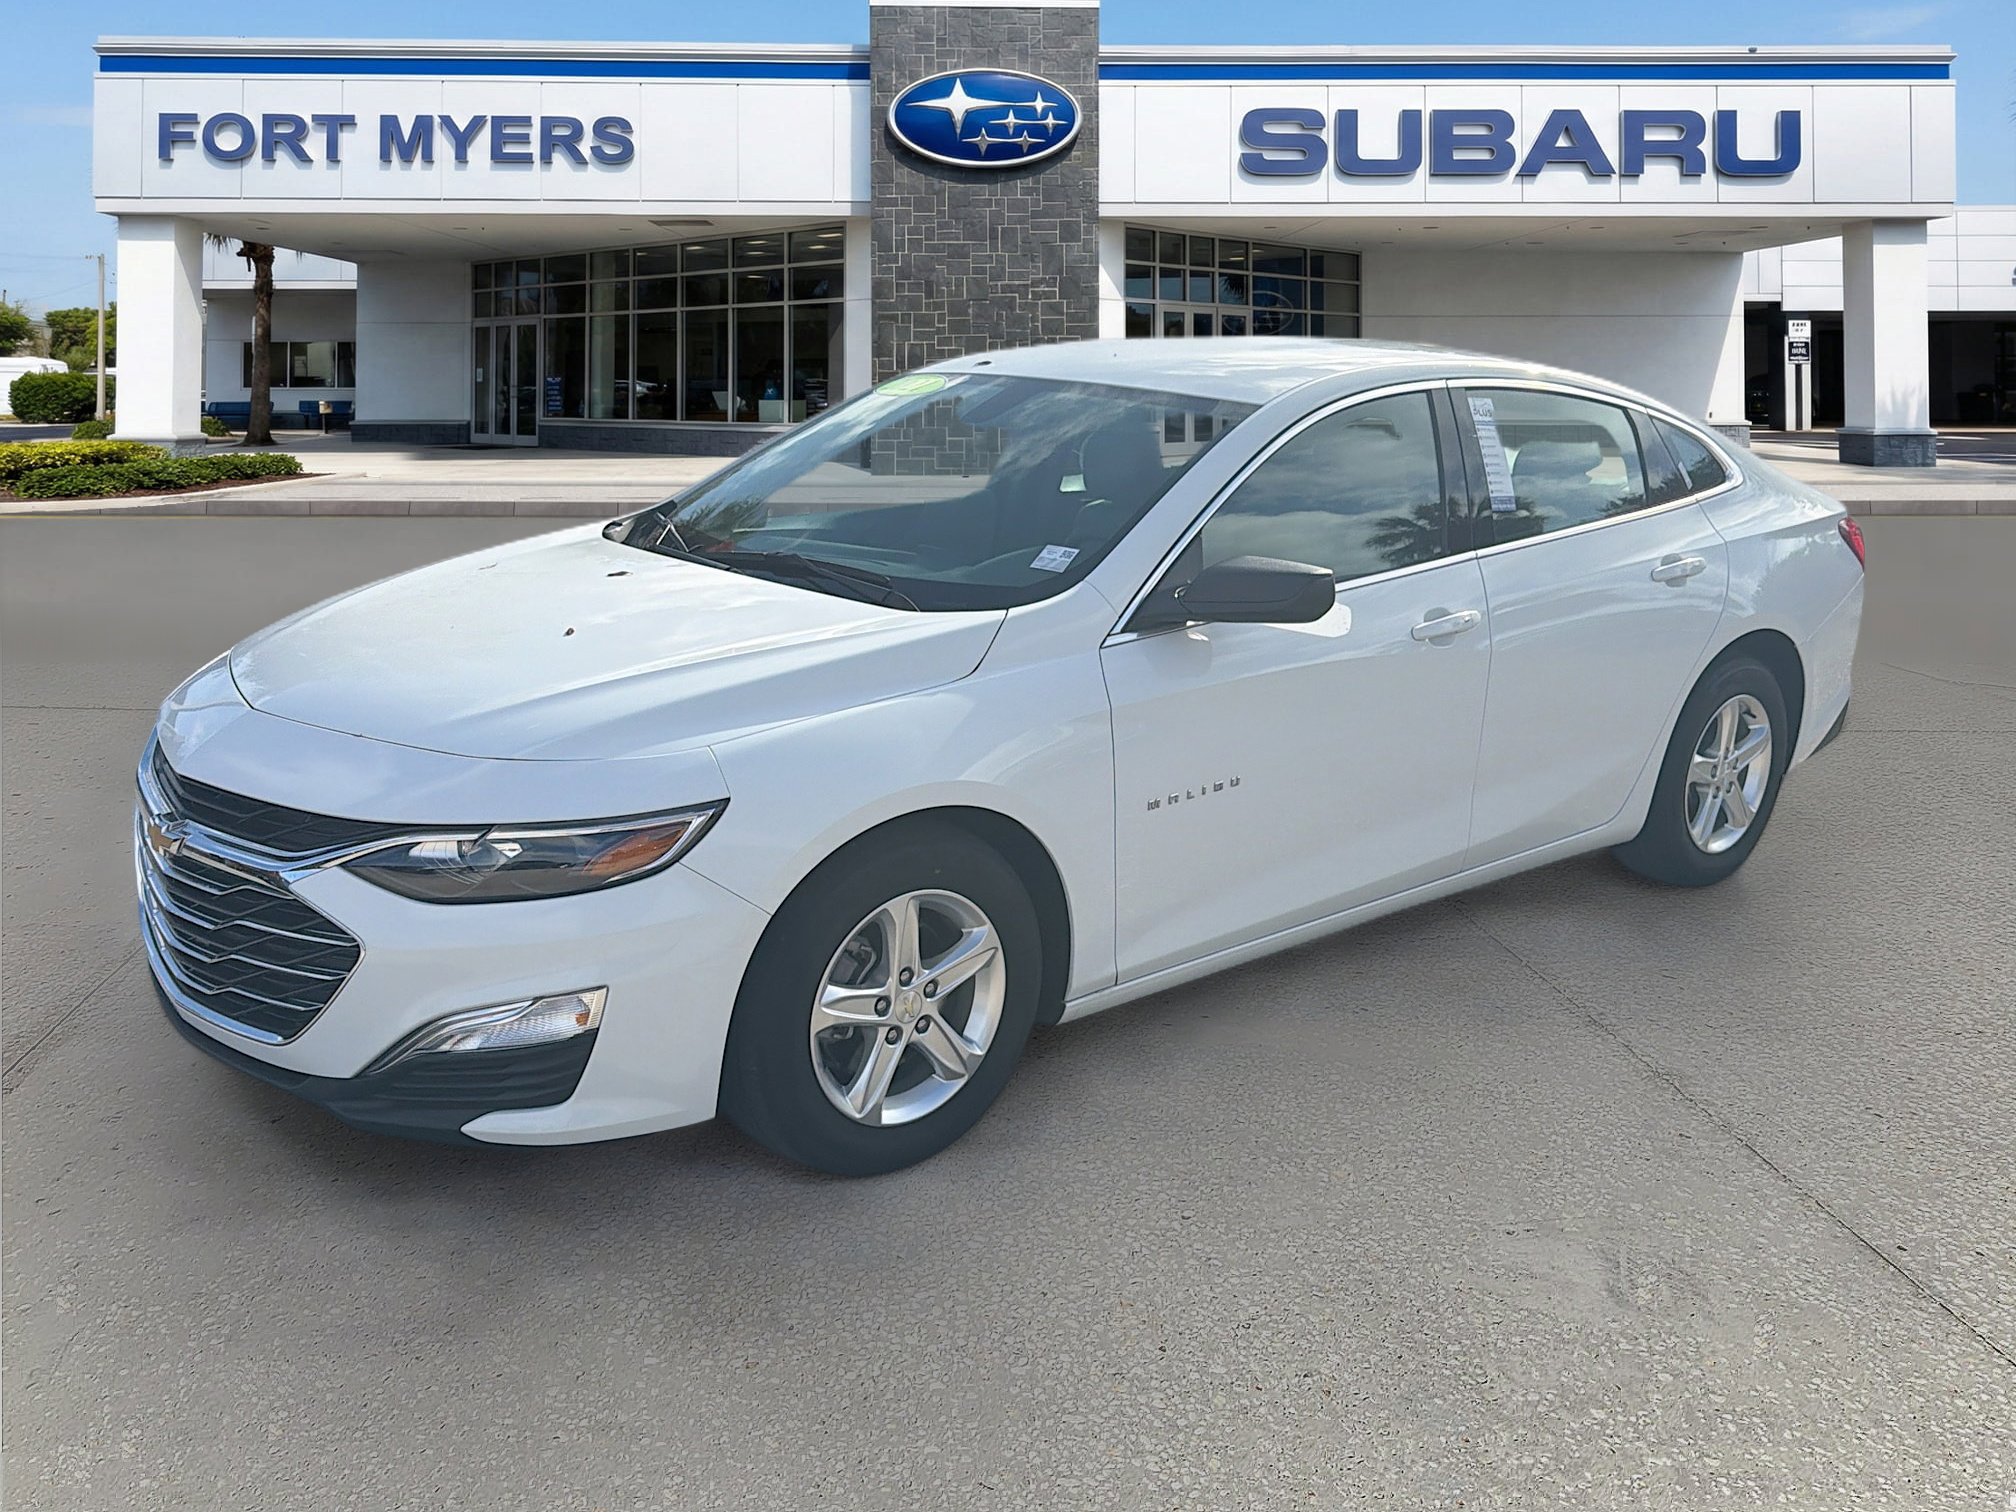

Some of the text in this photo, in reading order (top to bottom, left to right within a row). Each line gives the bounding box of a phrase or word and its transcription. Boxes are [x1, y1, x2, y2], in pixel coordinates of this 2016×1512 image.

[158, 112, 636, 166] FORT MYERS
[1239, 107, 1802, 179] SUBARU
[1147, 775, 1241, 811] MALIBU
